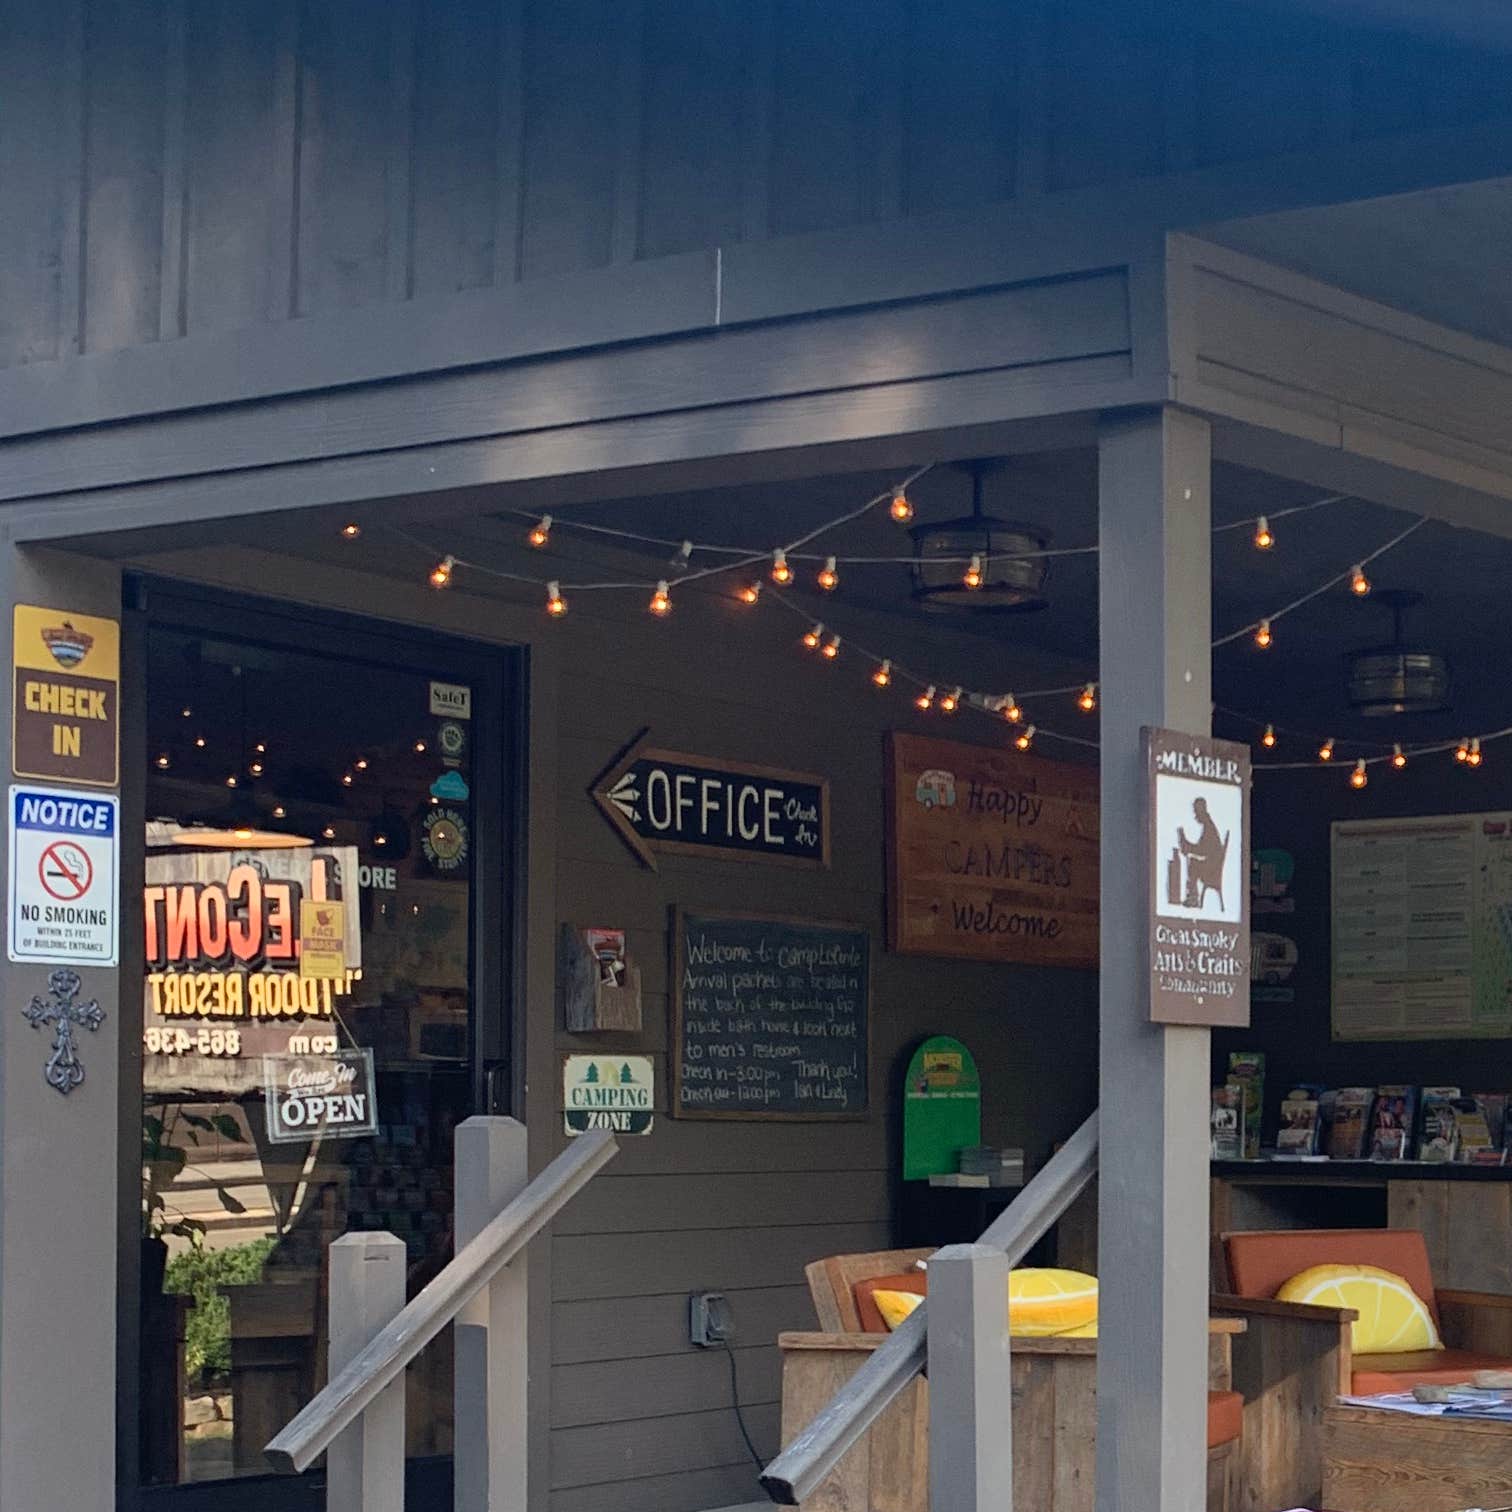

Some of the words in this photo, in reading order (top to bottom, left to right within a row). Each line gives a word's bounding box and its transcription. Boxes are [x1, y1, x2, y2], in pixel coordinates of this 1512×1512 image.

[24, 680, 108, 721] CHECK
[52, 724, 81, 757] IN
[1161, 750, 1241, 784] MEMBER
[21, 797, 109, 831] NOTICE
[647, 769, 785, 845] OFFICE
[783, 797, 818, 823] Check
[968, 778, 1044, 827] Happy
[795, 823, 818, 847] In
[333, 862, 397, 890] SORE
[944, 838, 1073, 889] CAMPERS
[21, 904, 40, 922] NO
[44, 905, 108, 926] SMOKING
[952, 901, 1065, 939] Welcome
[23, 938, 32, 947] OF
[34, 939, 67, 951] BUILDING
[69, 940, 104, 953] ENTRANCE
[37, 926, 62, 937] WITHIN
[74, 928, 92, 939] FEET
[1191, 928, 1240, 953] Smoky
[687, 933, 752, 966] Welcome
[1154, 950, 1184, 973] Arts
[682, 967, 728, 990] Arrival
[687, 1039, 703, 1060] to
[287, 1067, 331, 1089] Come
[334, 1062, 358, 1083] In
[571, 1086, 648, 1107] CAMPING
[281, 1094, 366, 1127] OPEN
[587, 1111, 632, 1132] ZONE
